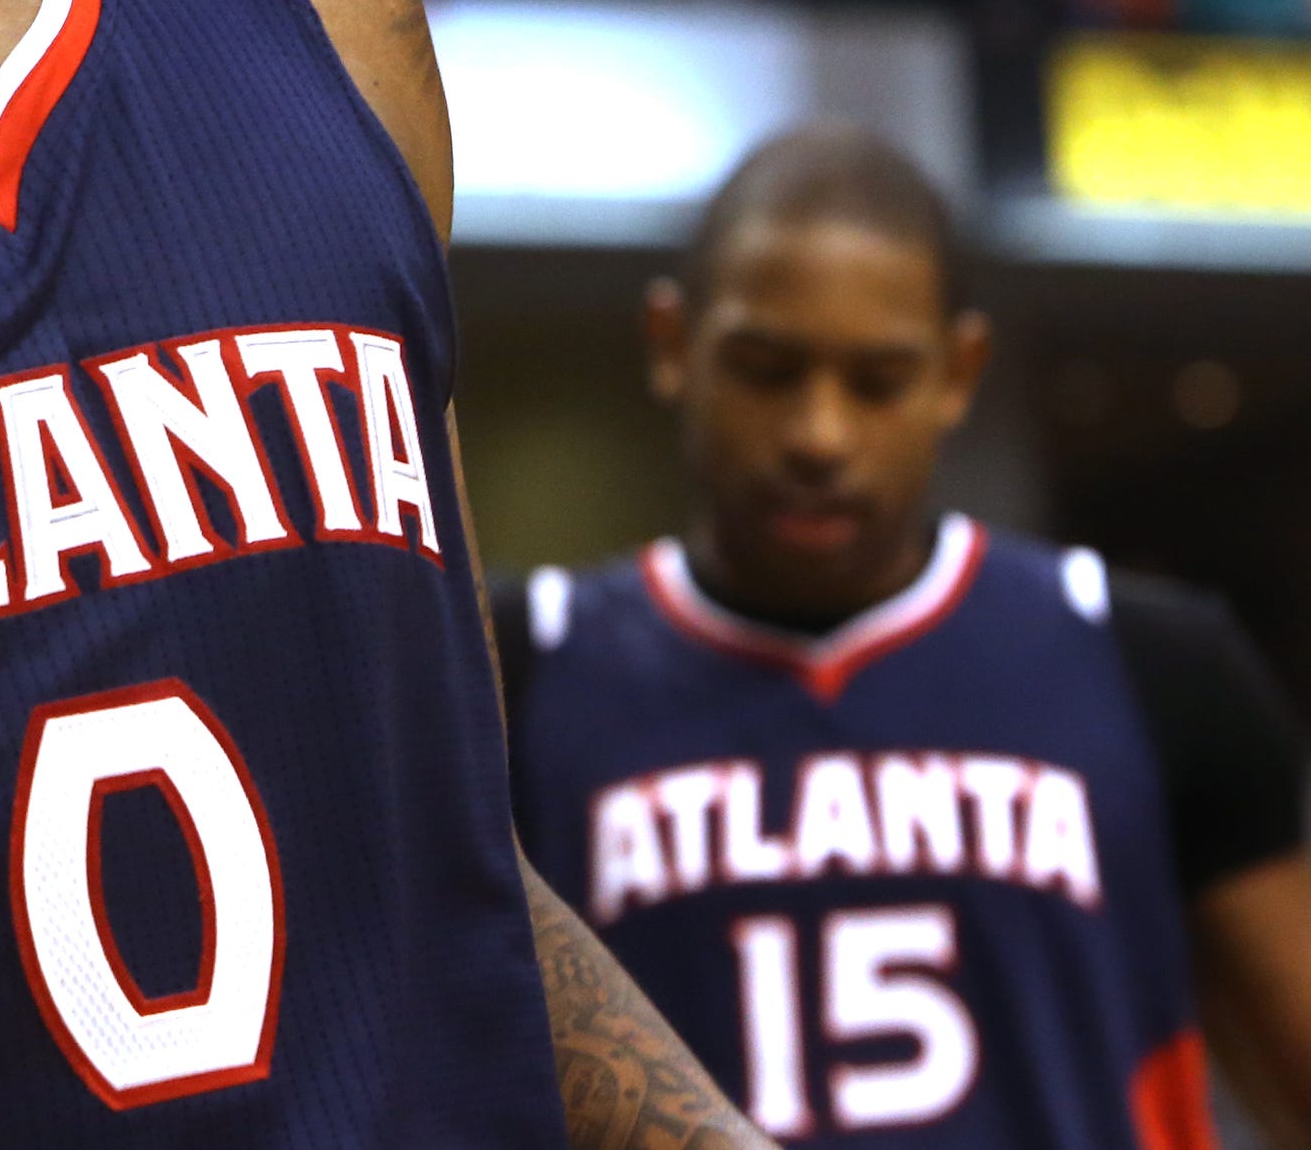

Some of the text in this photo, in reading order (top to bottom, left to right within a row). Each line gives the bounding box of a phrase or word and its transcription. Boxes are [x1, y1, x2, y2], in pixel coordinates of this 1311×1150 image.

[11, 681, 284, 1106] 0
[592, 753, 1099, 924] ATLANTA
[735, 907, 978, 1136] 15
